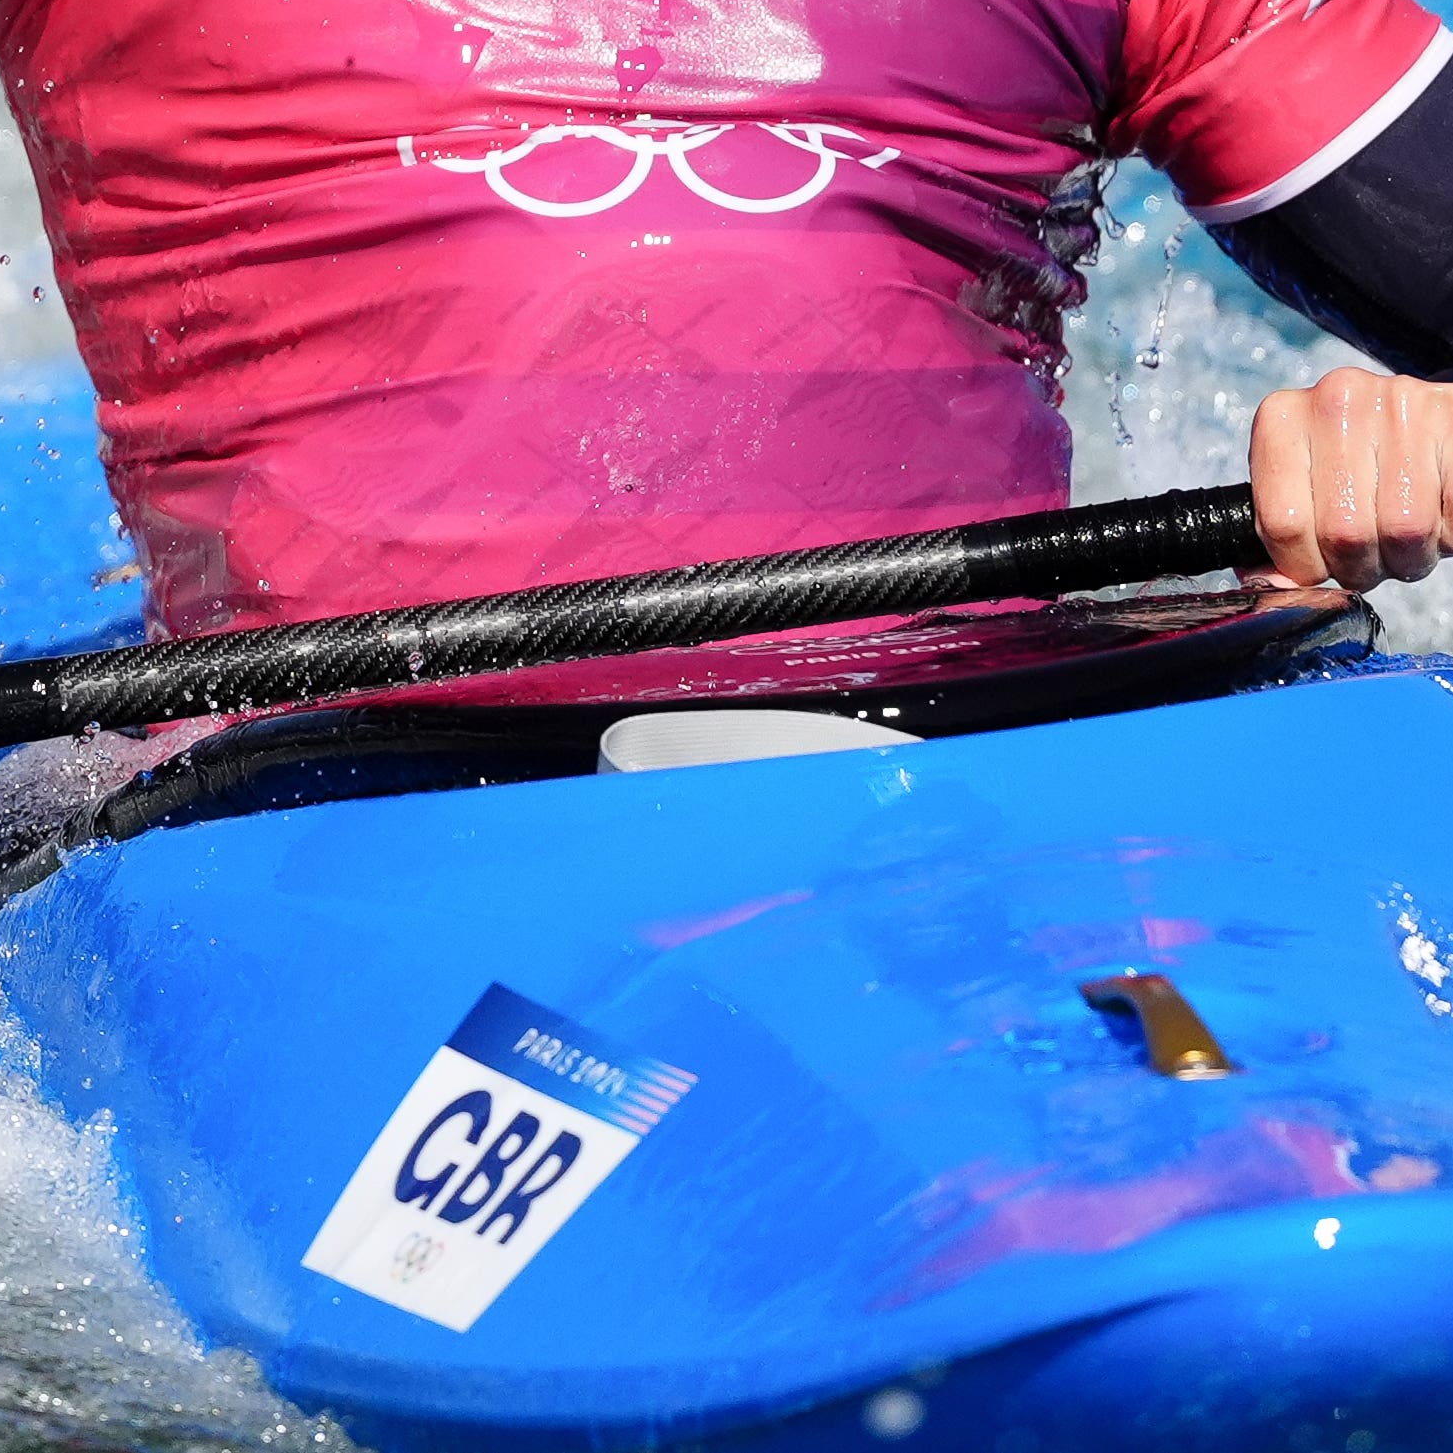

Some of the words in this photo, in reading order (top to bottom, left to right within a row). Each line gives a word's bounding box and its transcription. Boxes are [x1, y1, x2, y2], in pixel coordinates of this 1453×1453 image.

[783, 650, 882, 667] PARIS
[512, 1027, 582, 1076] PARIS
[394, 1089, 582, 1245] GBR
